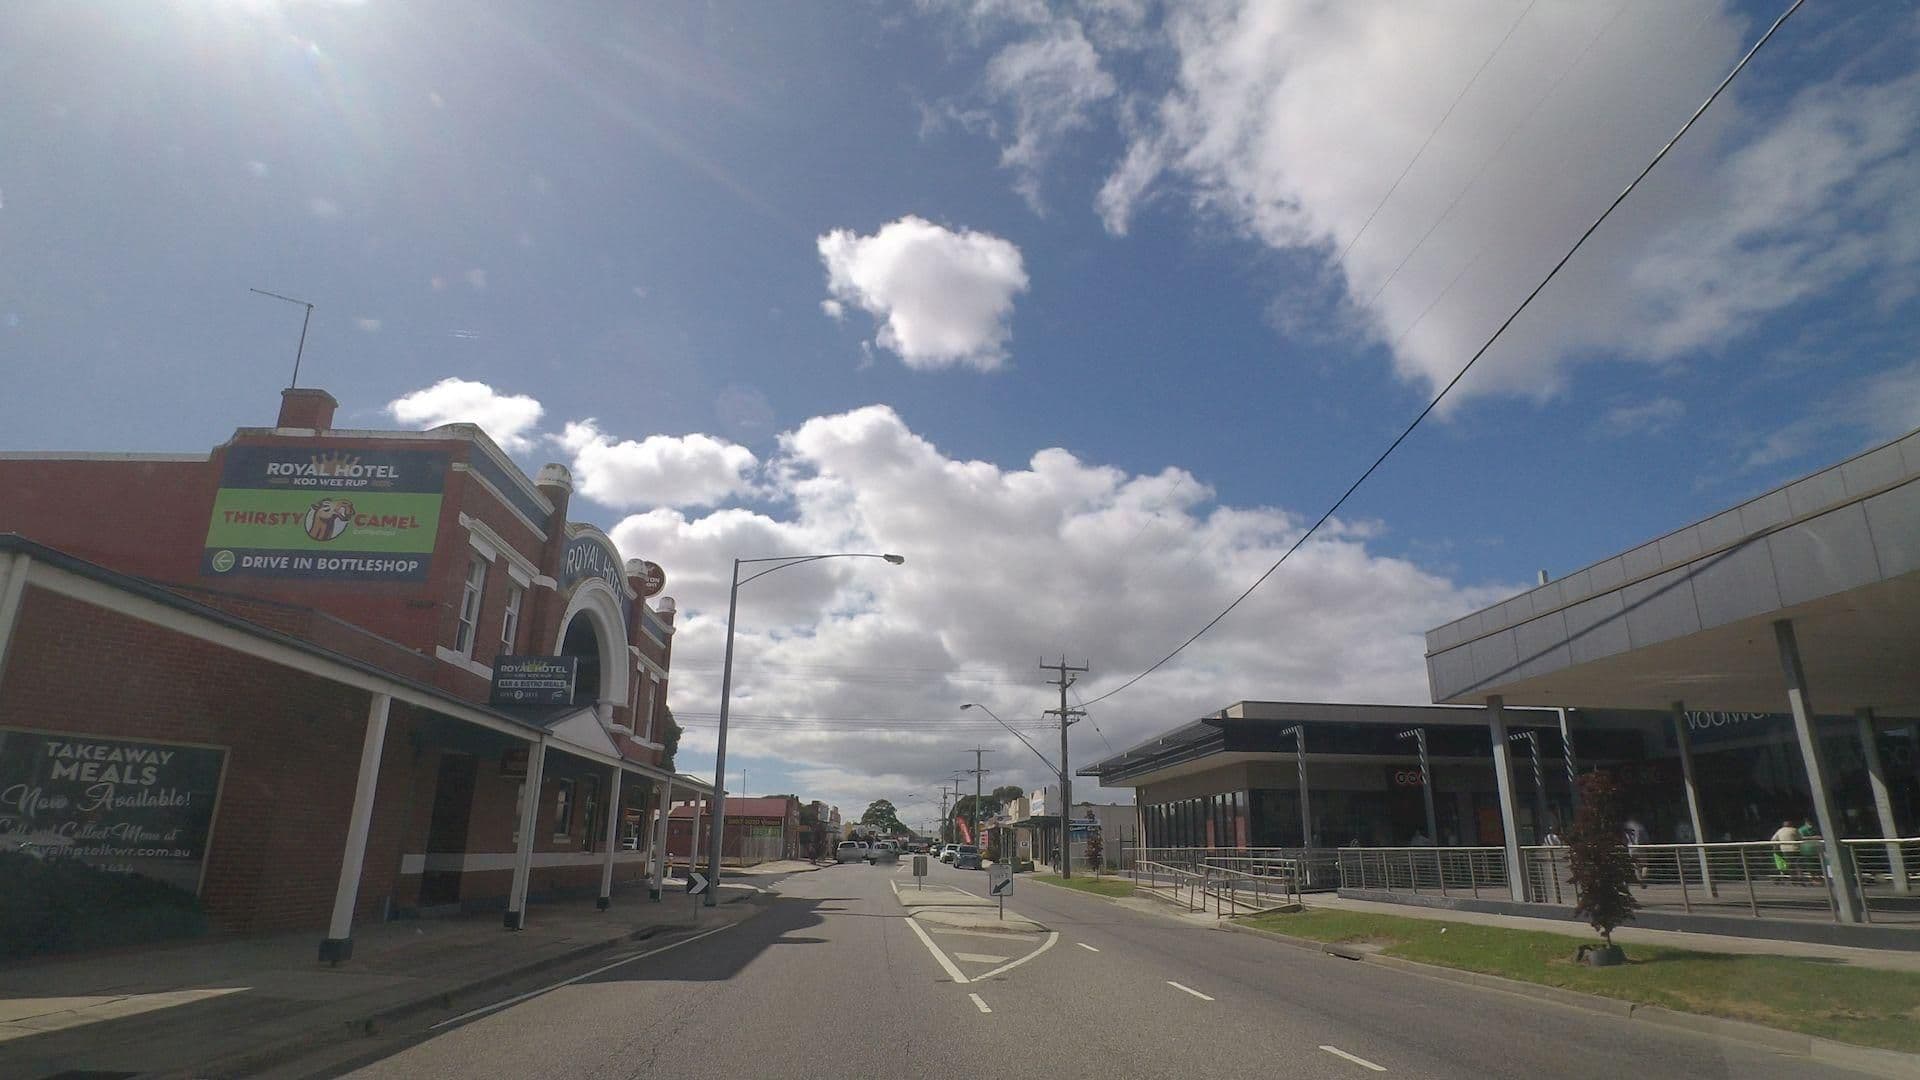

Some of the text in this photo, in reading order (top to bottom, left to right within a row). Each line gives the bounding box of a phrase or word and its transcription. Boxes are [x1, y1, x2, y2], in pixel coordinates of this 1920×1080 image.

[266, 462, 400, 478] ROYAL HOTEL
[293, 478, 368, 487] KOO WEE RUP
[224, 510, 421, 529] THIRSTY CAMEL
[241, 555, 419, 573] DRIVE IN BOTTLESHOP
[566, 543, 600, 575] ROYAL
[500, 664, 568, 673] ROYAL HOTEL
[46, 742, 175, 765] TAKEAWAY
[50, 760, 157, 786] MEALS
[1, 782, 192, 817] Now Available!
